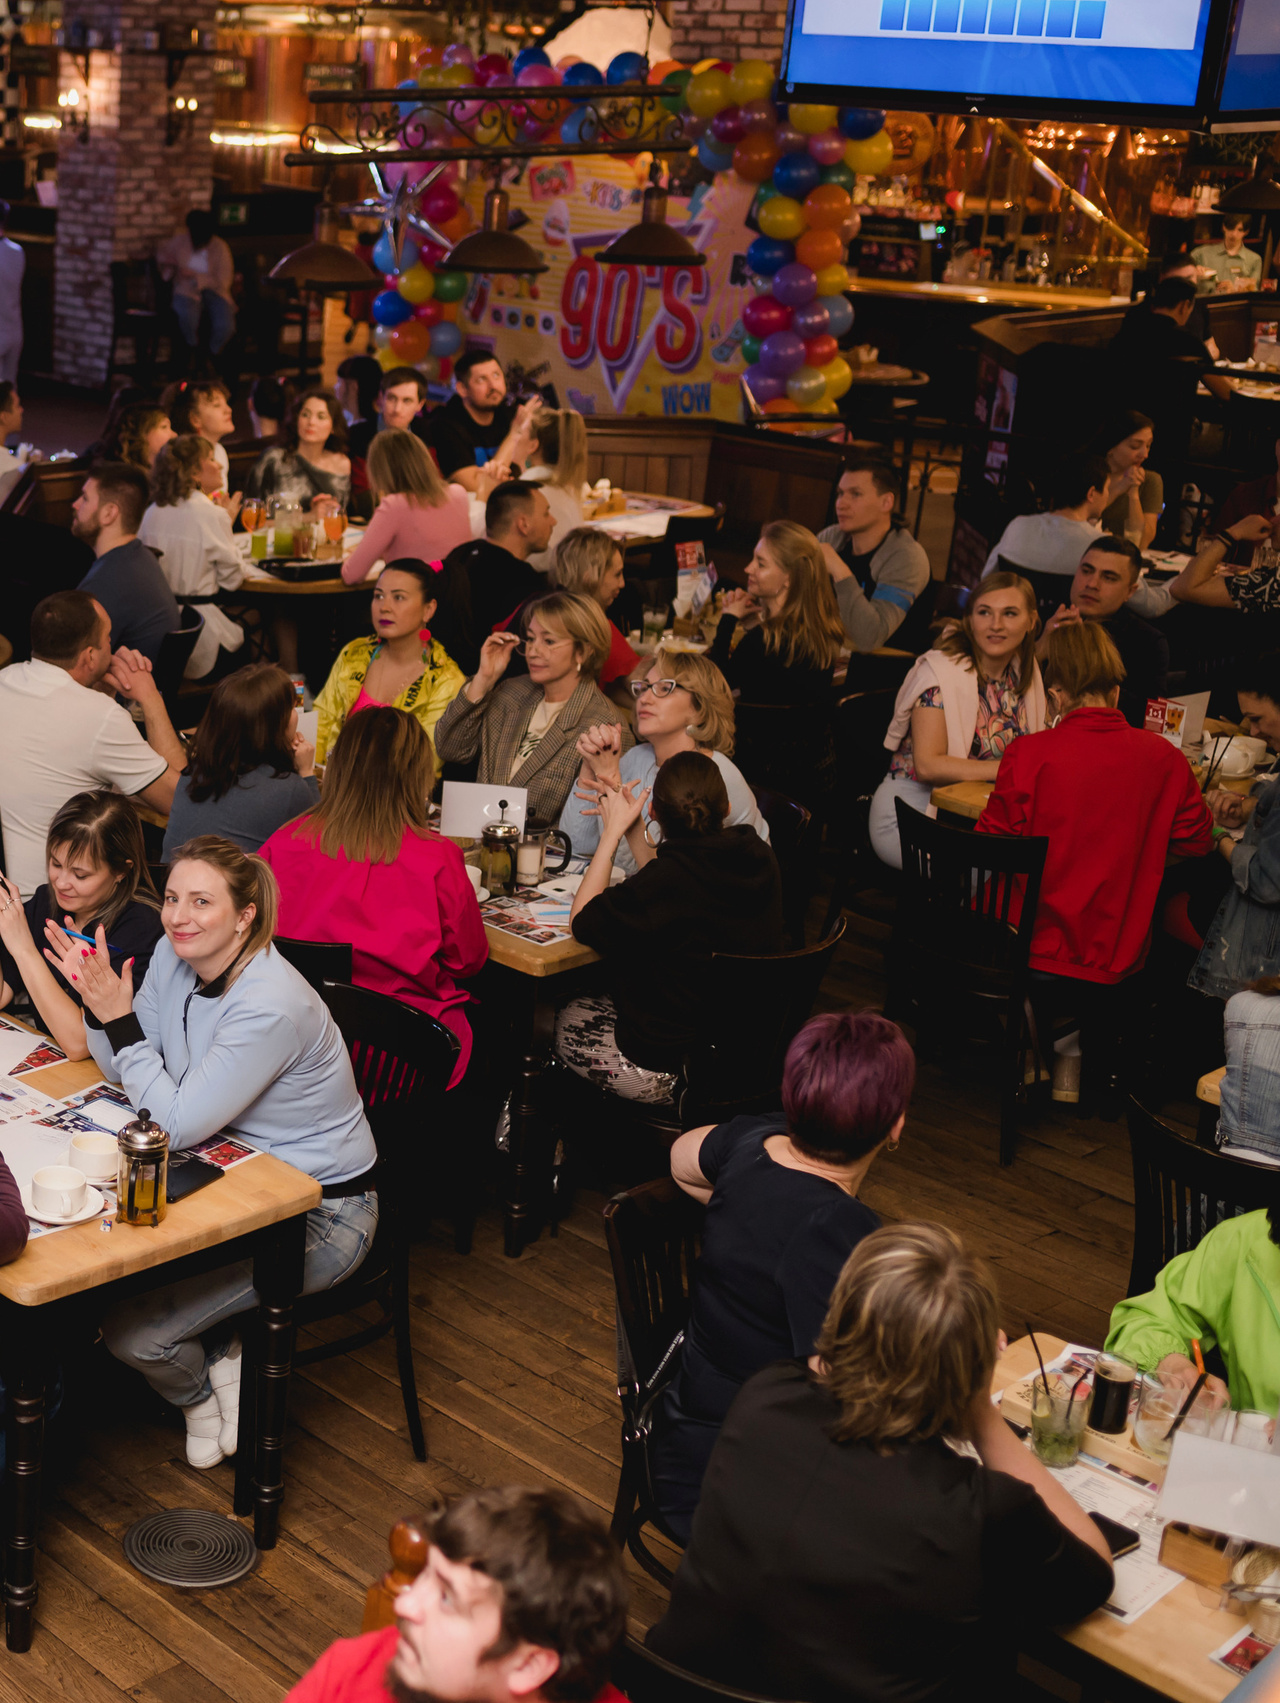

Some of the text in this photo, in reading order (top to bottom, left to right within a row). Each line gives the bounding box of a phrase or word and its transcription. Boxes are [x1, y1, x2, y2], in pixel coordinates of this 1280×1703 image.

[560, 256, 707, 370] 90'S
[662, 383, 711, 415] WOW
[1148, 708, 1162, 718] 1+1
